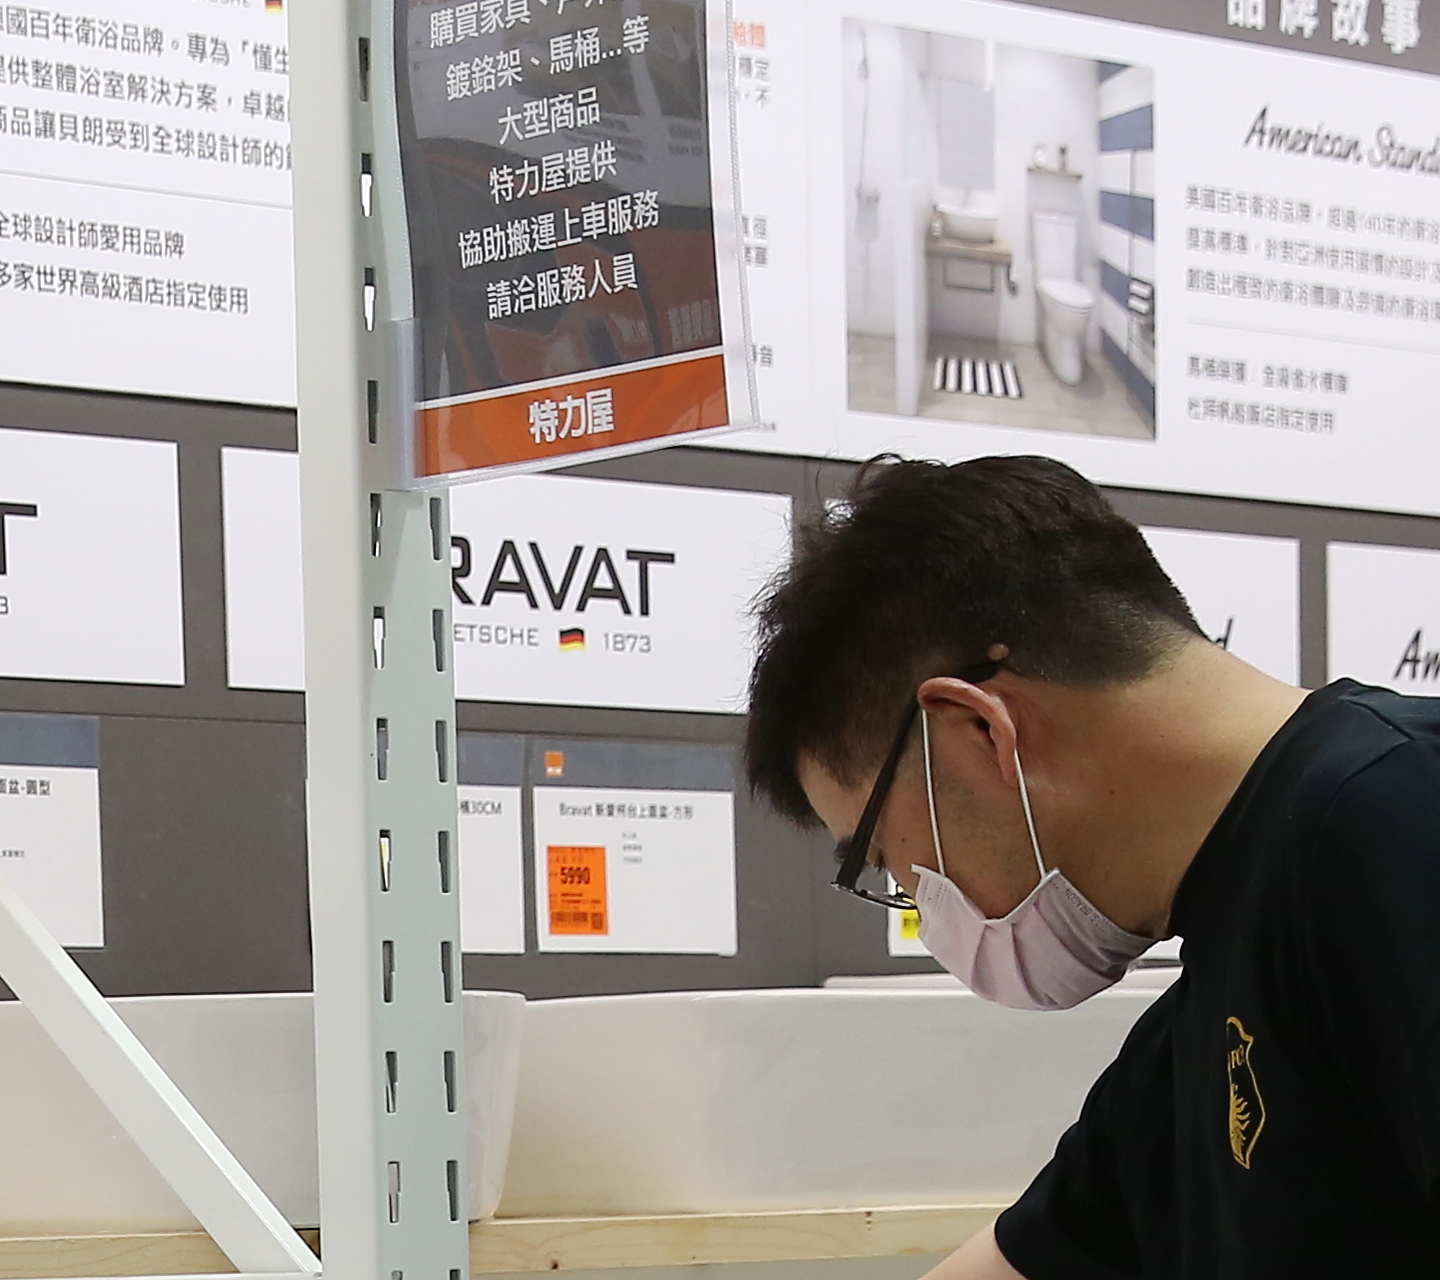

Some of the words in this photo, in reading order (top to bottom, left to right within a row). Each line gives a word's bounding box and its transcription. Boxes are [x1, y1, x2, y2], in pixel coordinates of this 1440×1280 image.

[497, 86, 601, 146] 大型商品
[1243, 104, 1362, 165] American
[488, 140, 618, 205] 特力屋提供
[457, 189, 660, 271] 協助搬運上車服務
[485, 252, 639, 321] 請洽服務人員
[528, 387, 615, 445] 特力屋
[451, 535, 677, 618] RAVAT
[453, 622, 540, 648] ETSCHE
[602, 631, 653, 655] 1873
[559, 866, 591, 885] 5990
